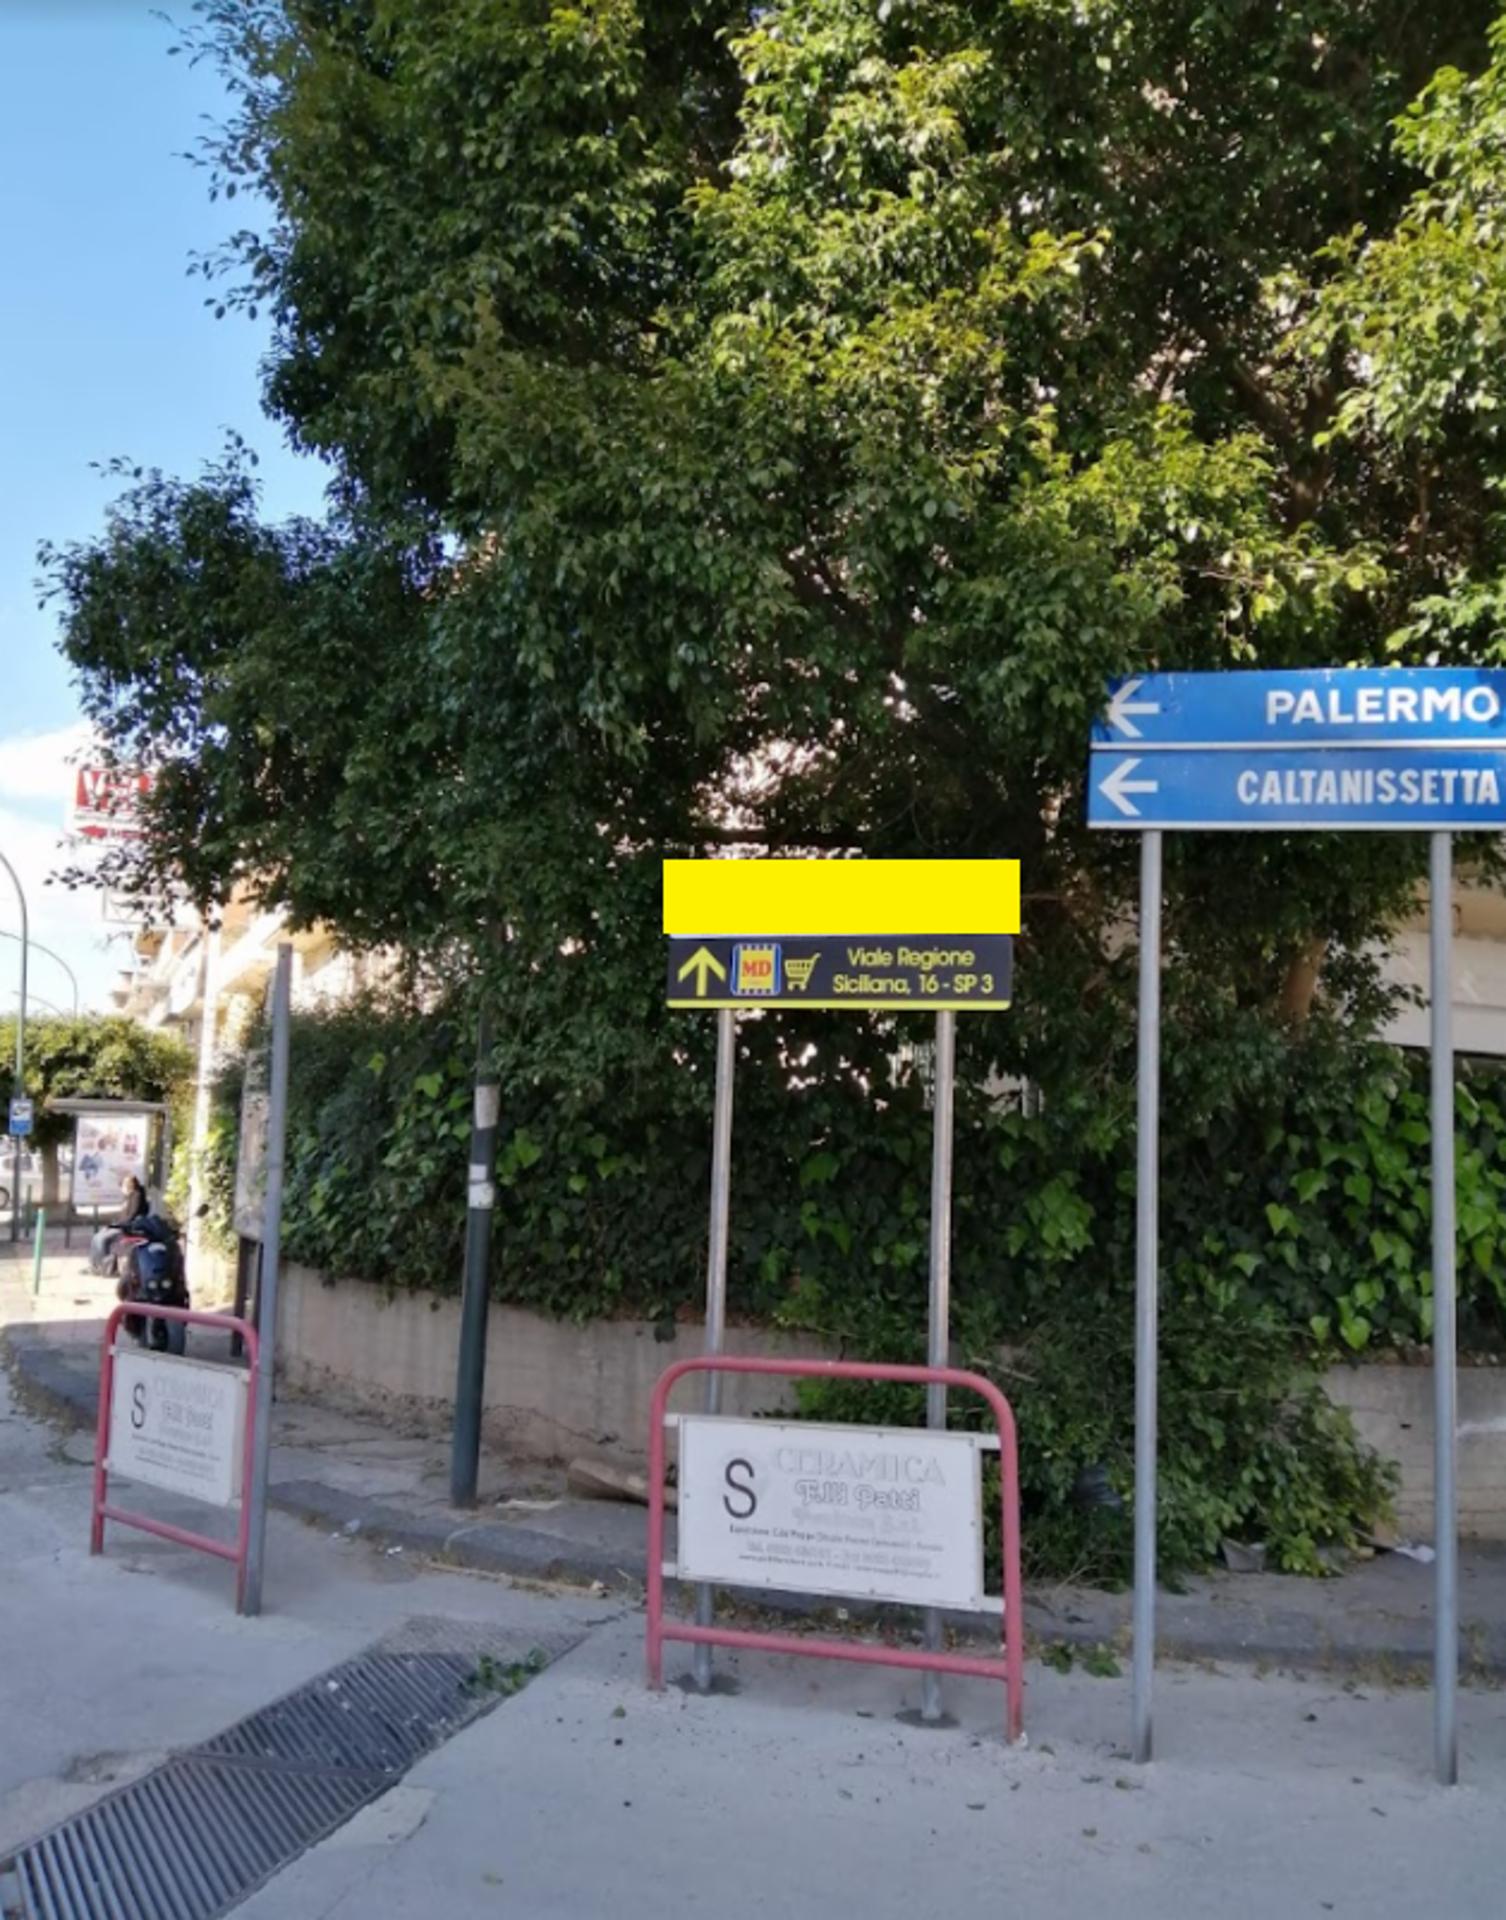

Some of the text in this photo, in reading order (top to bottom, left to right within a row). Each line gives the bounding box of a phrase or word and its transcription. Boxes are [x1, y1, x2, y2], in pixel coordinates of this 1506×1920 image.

[1266, 686, 1499, 724] PALERMO
[1237, 769, 1499, 806] CALTANISSETTA
[742, 960, 772, 977] MD
[847, 947, 975, 970] Viale Regione
[832, 974, 911, 995] Siciliana,
[919, 975, 938, 992] 16
[953, 975, 978, 993] SP
[981, 975, 994, 994] 3
[776, 1447, 947, 1487] CERAMICA
[722, 1458, 757, 1519] S
